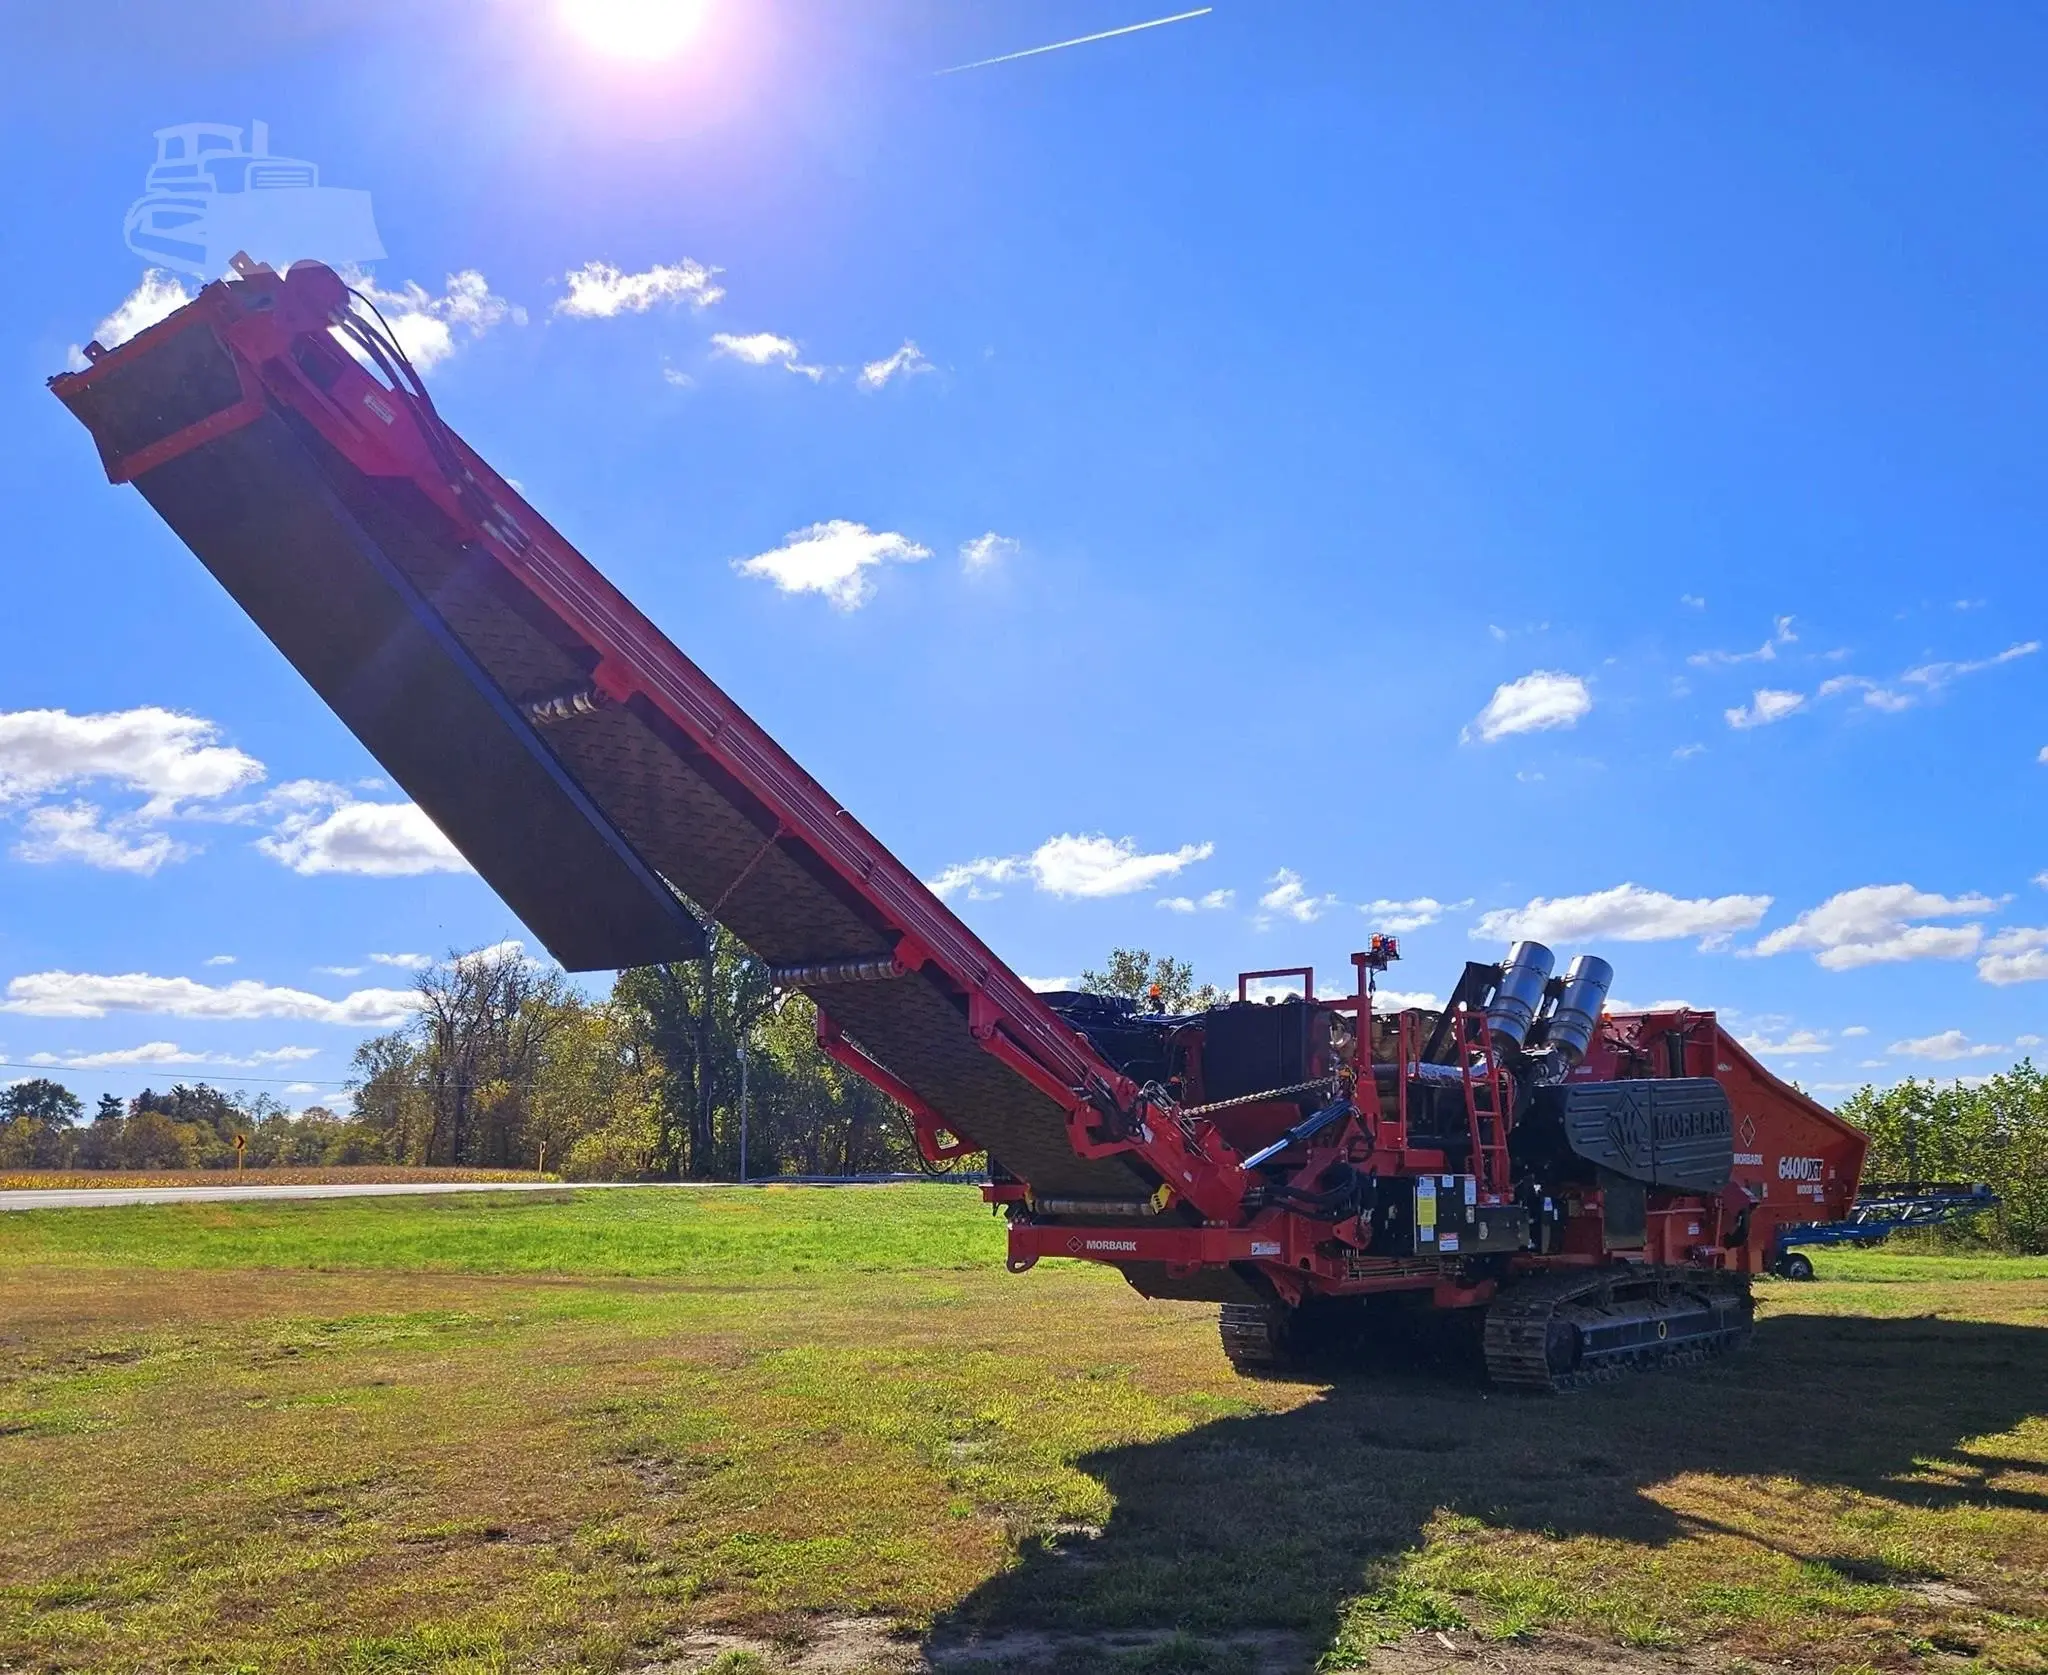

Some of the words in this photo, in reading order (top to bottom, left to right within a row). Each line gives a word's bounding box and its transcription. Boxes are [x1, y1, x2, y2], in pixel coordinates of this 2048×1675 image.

[1734, 1153, 1763, 1166] MORBARK
[1779, 1156, 1824, 1181] 6400XT
[1086, 1240, 1137, 1251] MORBARK
